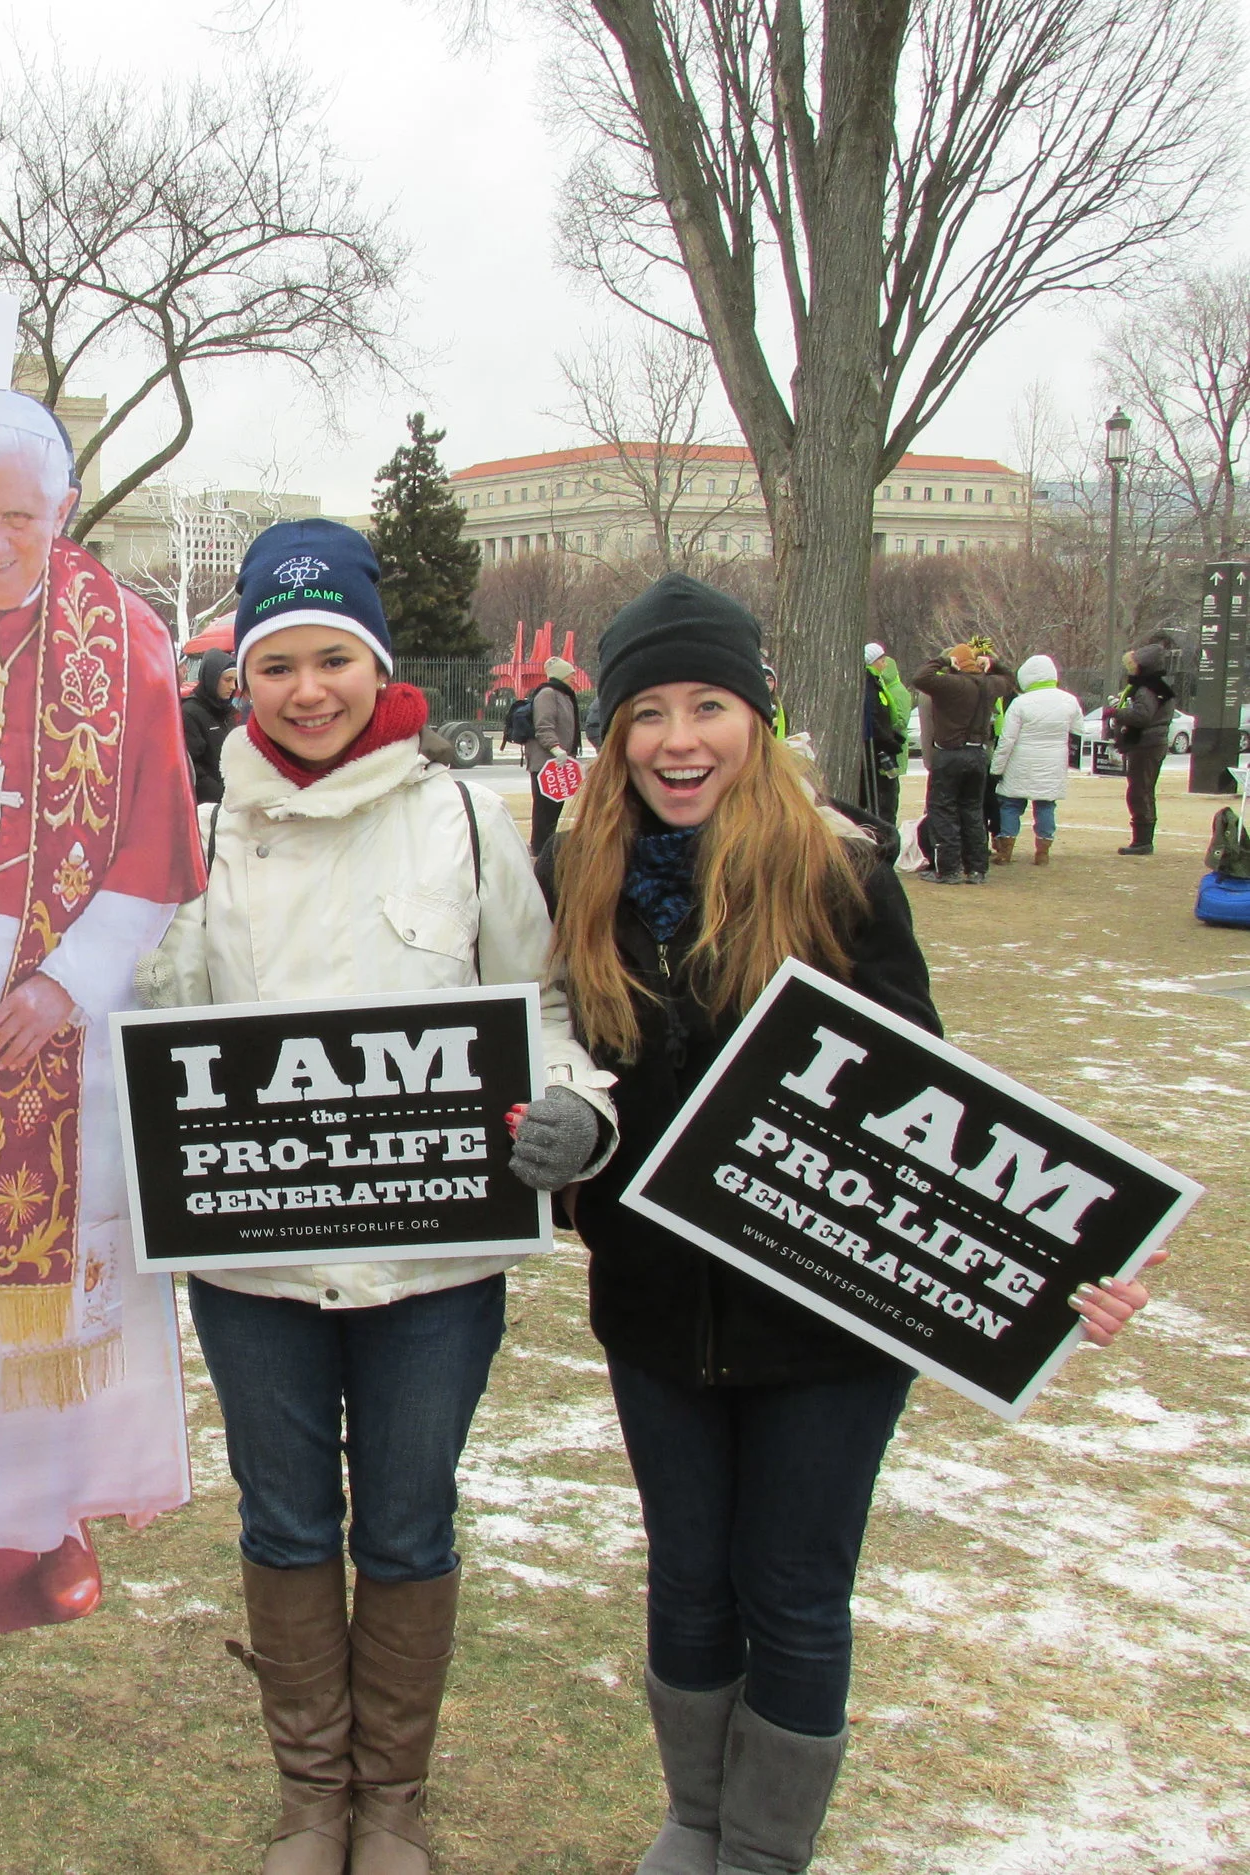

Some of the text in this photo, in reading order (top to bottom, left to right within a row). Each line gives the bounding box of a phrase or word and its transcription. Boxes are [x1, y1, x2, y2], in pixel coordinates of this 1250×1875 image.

[255, 588, 344, 614] NOTRE DAME
[545, 769, 558, 794] STOP
[554, 765, 569, 797] ABORTIO
[565, 762, 578, 789] NOW
[171, 1026, 483, 1110] I AM
[310, 1109, 347, 1124] the
[180, 1127, 488, 1176] PRO-LIFE
[780, 1025, 1115, 1245] I AM
[186, 1176, 489, 1215] GENERATION
[895, 1164, 932, 1193] the
[239, 1218, 440, 1239] WWW.STUDENTSFORLIFE.ORG
[735, 1116, 1046, 1307] PRO-LIFE
[713, 1164, 1012, 1340] GENERATION
[742, 1223, 935, 1338] WWW.STUDENTSFORLIFE.ORG
